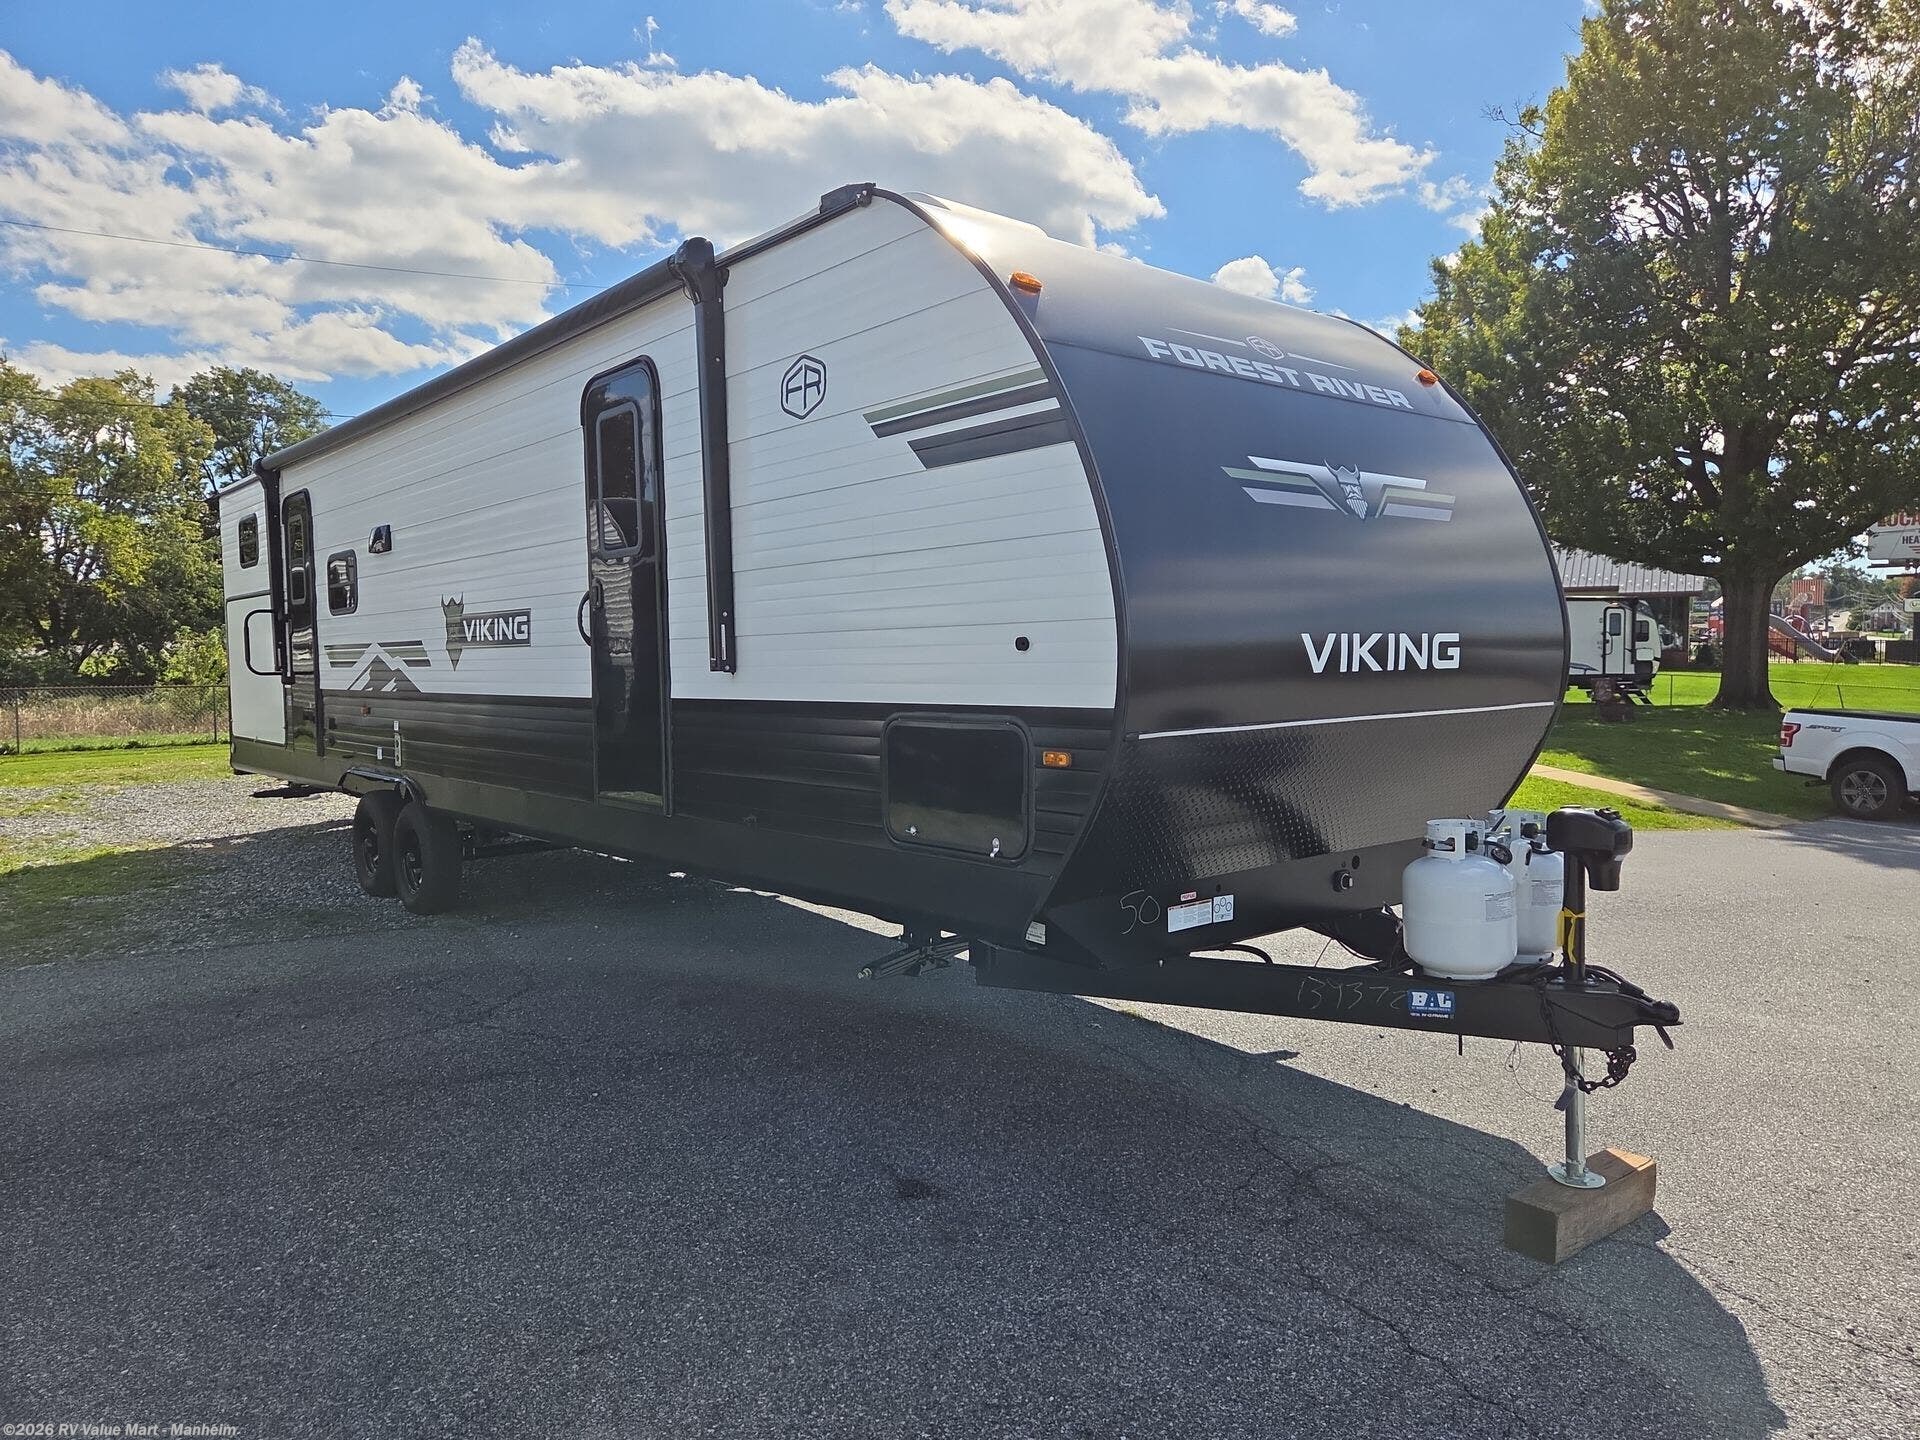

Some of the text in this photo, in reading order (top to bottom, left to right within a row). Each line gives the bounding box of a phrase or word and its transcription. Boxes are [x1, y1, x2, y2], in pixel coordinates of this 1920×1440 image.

[1137, 336, 1414, 410] FOREST RIVER
[1877, 508, 1920, 527] OCA
[1902, 535, 1920, 545] HEA
[462, 615, 529, 642] VIKING
[1300, 633, 1460, 674] VIKING
[1120, 889, 1160, 935] 50
